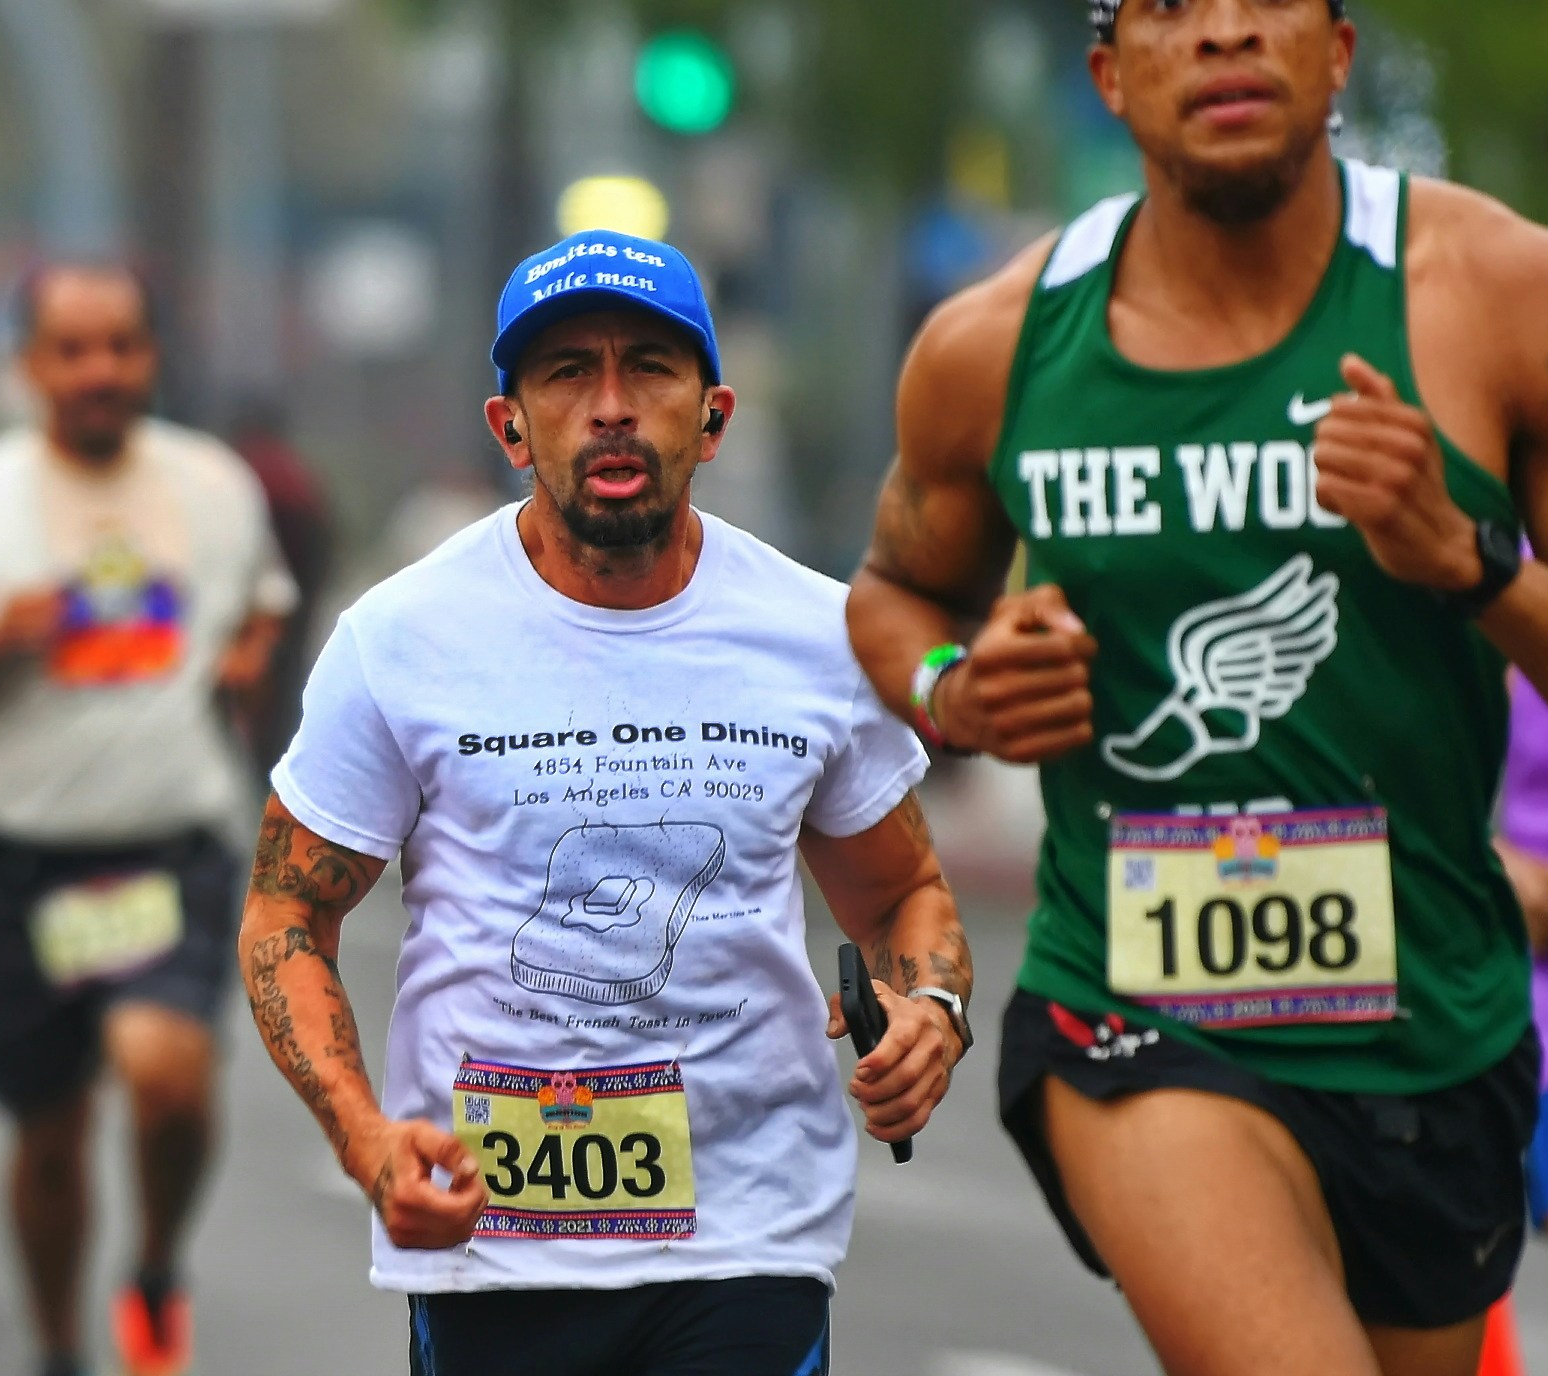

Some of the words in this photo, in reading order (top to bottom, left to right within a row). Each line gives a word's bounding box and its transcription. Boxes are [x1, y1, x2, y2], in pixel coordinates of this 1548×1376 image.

[524, 243, 617, 284] Bonitas
[622, 246, 665, 267] ten
[532, 271, 587, 303] Mile
[595, 272, 657, 292] man
[1018, 445, 1161, 538] THE
[458, 730, 597, 756] Square
[612, 723, 686, 744] One
[701, 722, 808, 758] Dining
[533, 757, 583, 776] 4854
[595, 753, 693, 774] Fountain
[706, 753, 747, 772] Ave
[513, 788, 550, 806] Los
[561, 781, 650, 807] Angeles
[660, 779, 692, 798] CA
[704, 780, 764, 802] 90029
[1145, 892, 1361, 980] 1098
[529, 1008, 559, 1025] Best
[565, 1013, 620, 1028] French
[629, 1015, 669, 1029] Toast
[482, 1130, 666, 1200] 3403
[558, 1219, 594, 1234] 2021
